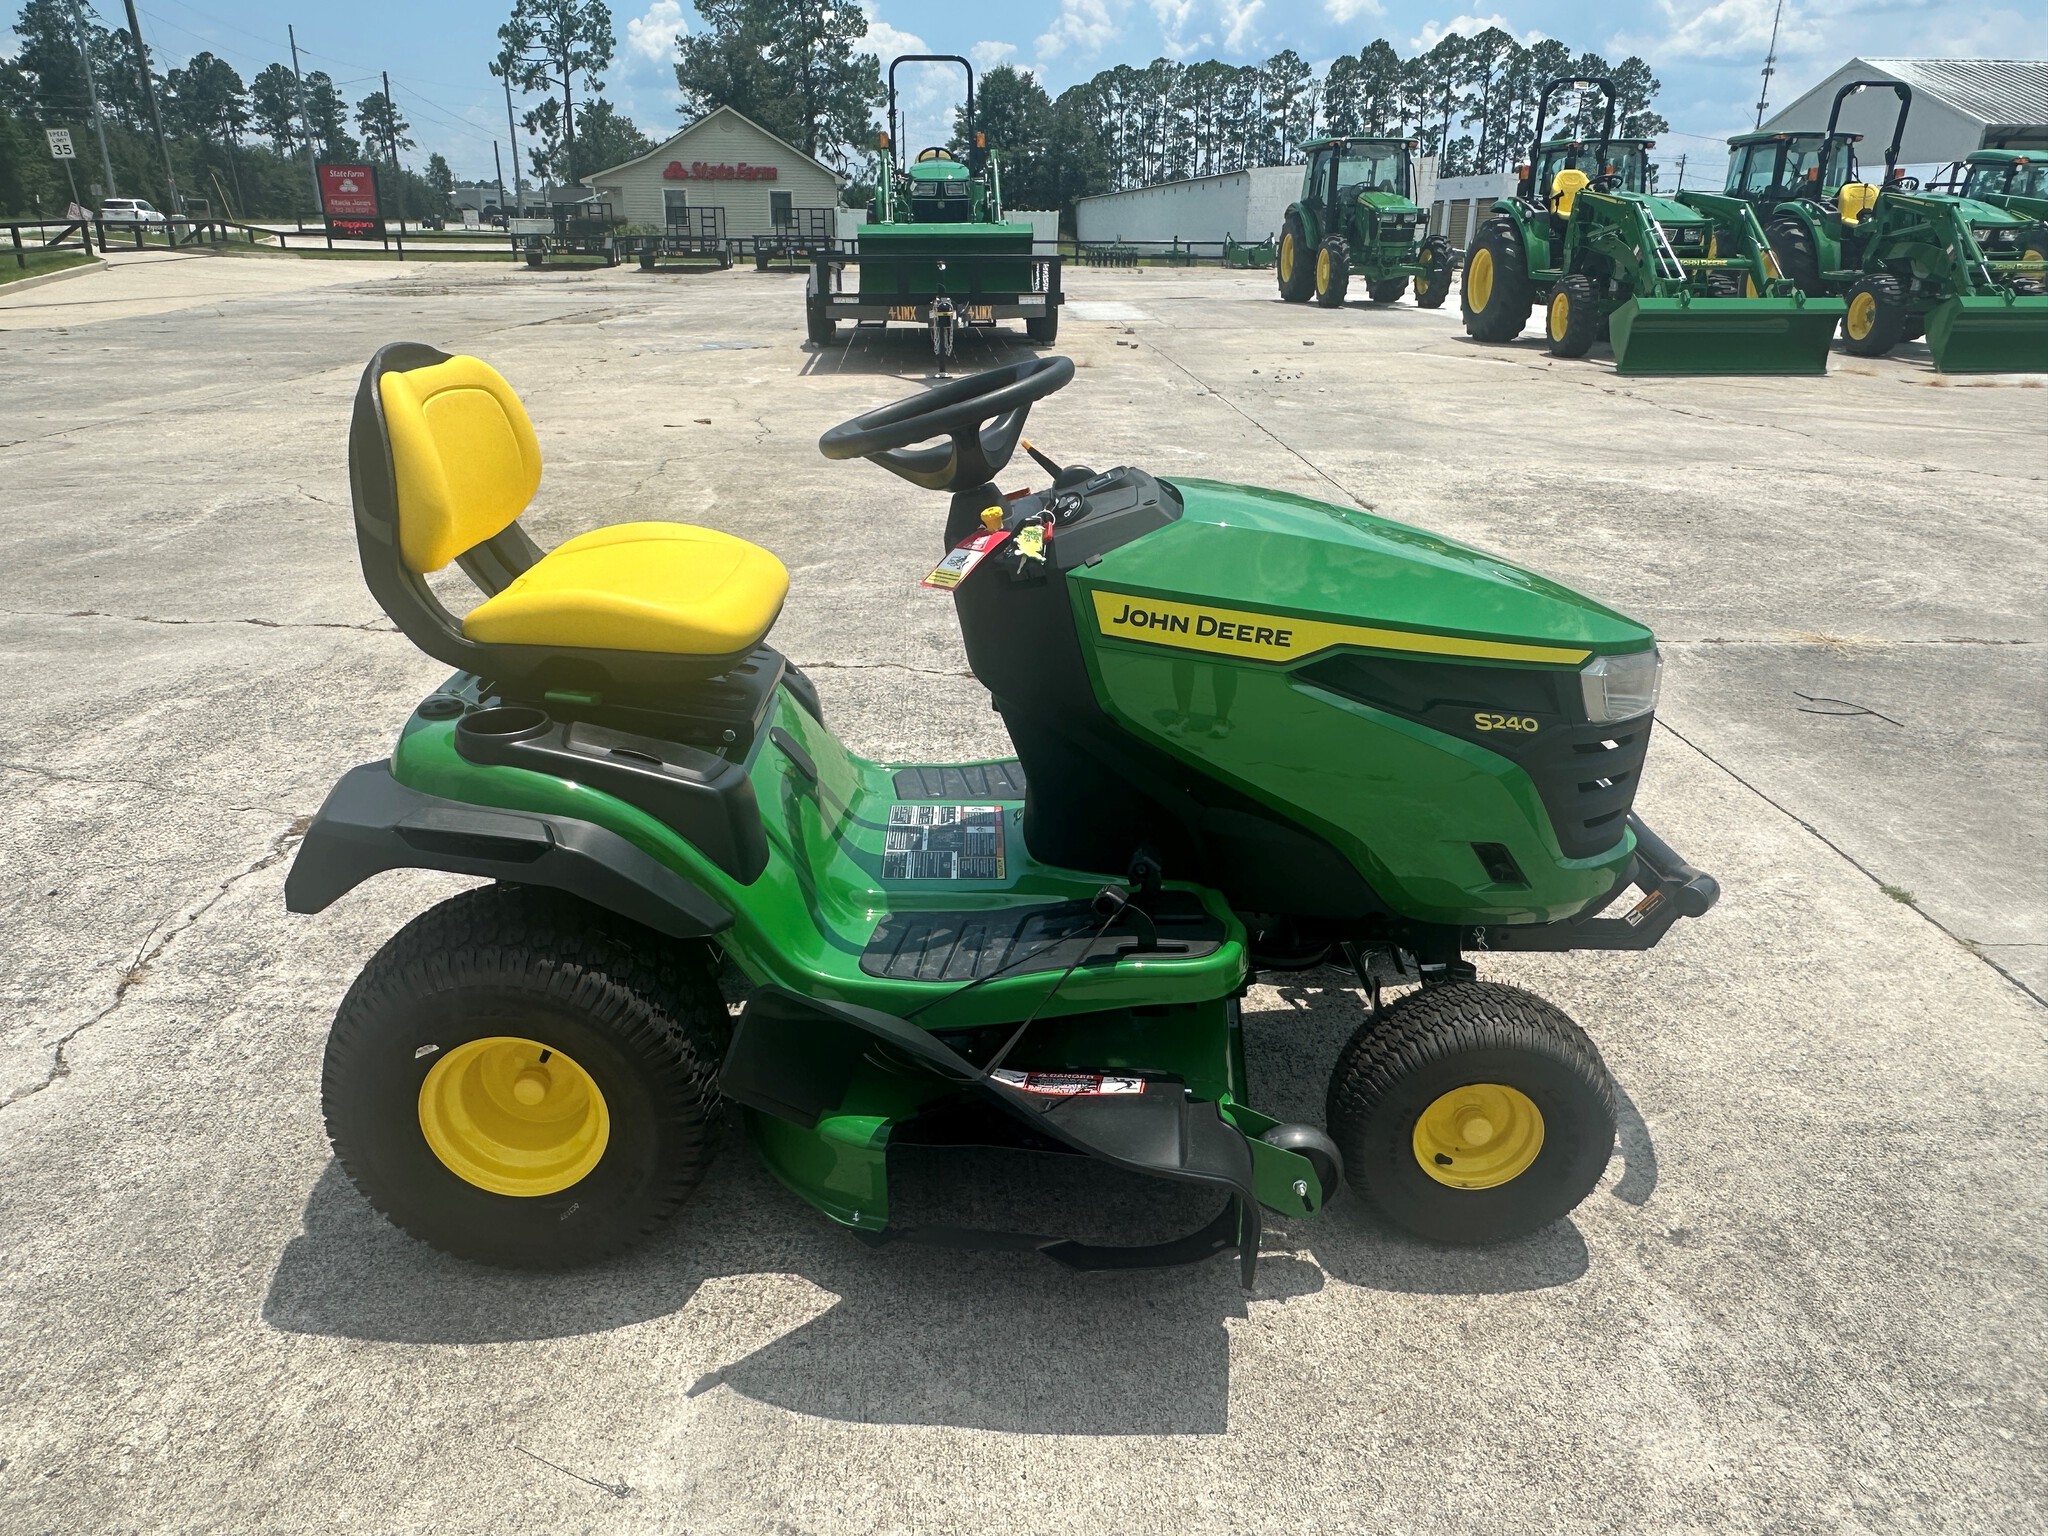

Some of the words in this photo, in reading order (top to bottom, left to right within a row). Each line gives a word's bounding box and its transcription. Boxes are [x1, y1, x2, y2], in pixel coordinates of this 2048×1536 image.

[53, 144, 72, 155] 35
[692, 161, 735, 180] State
[737, 162, 778, 180] Farm
[896, 305, 917, 321] LINX
[975, 305, 993, 320] LINX
[1112, 604, 1190, 634] JOHN
[1195, 615, 1293, 648] DEERE
[1473, 712, 1539, 732] S240
